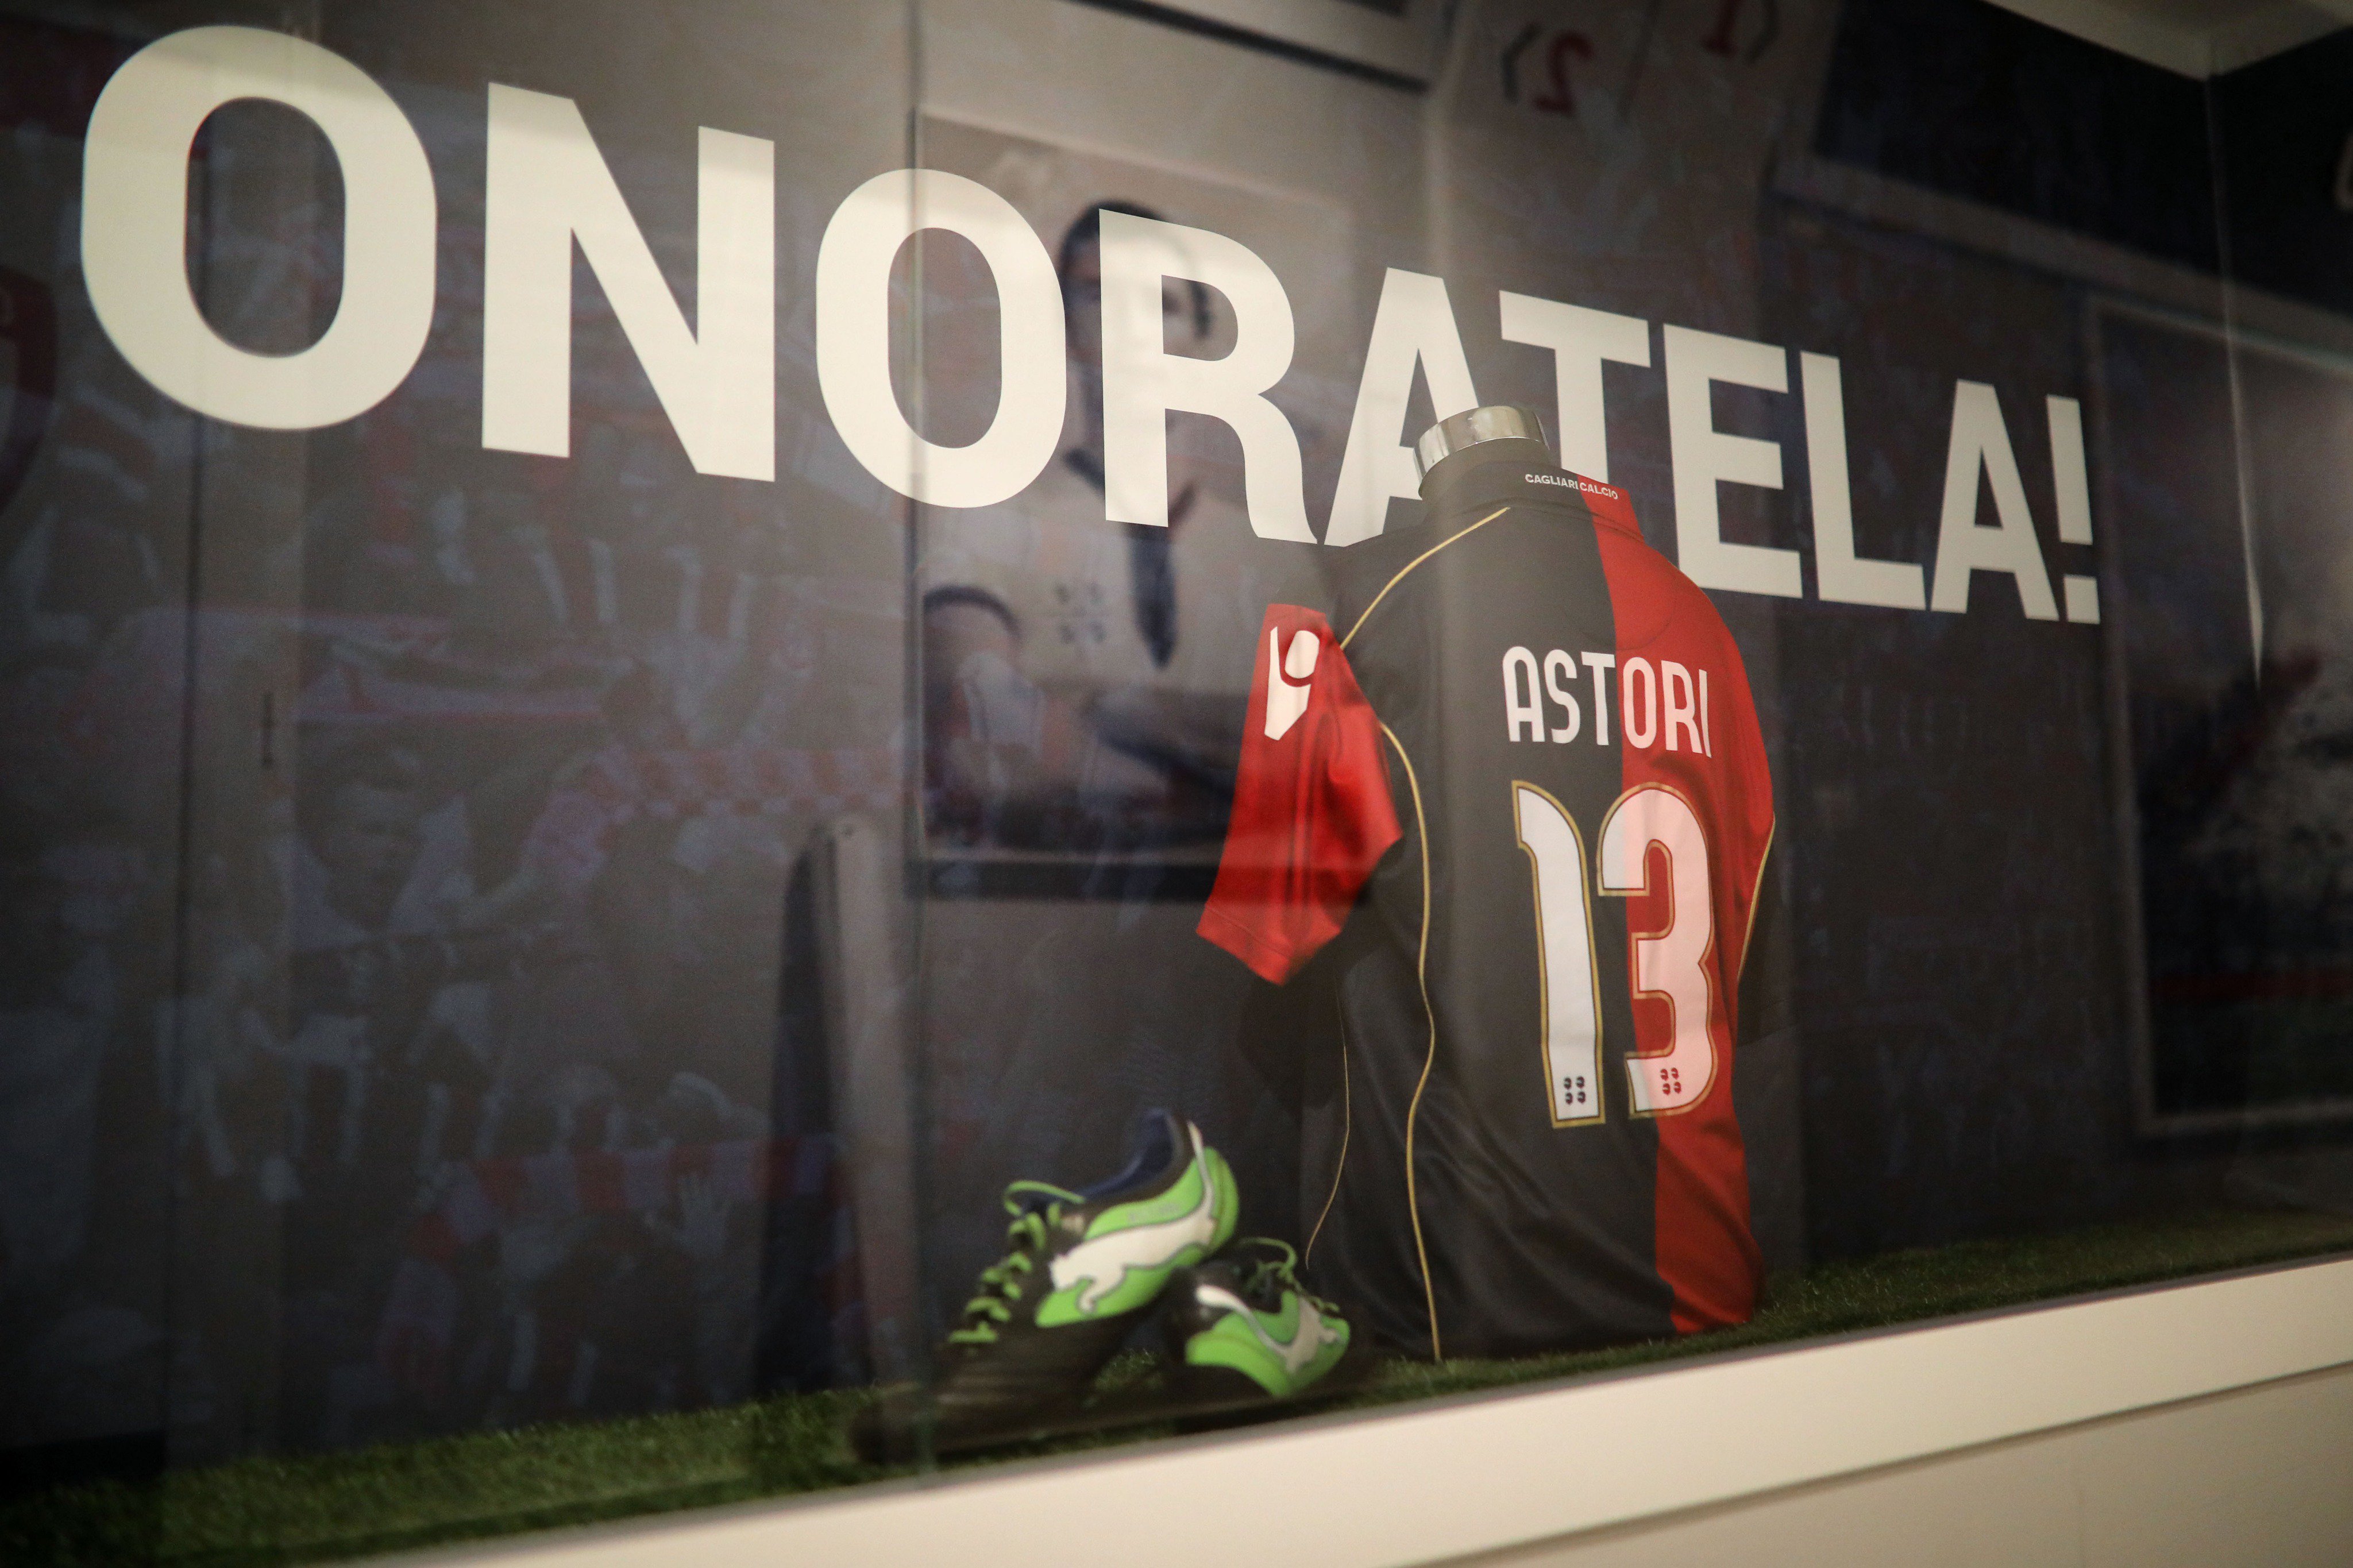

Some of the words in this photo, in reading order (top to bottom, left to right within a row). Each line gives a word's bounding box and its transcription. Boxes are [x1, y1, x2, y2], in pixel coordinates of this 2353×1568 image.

[80, 25, 2100, 625] ONORATELA!
[1502, 646, 1712, 759] ASTORI
[1511, 779, 1718, 1129] 13
